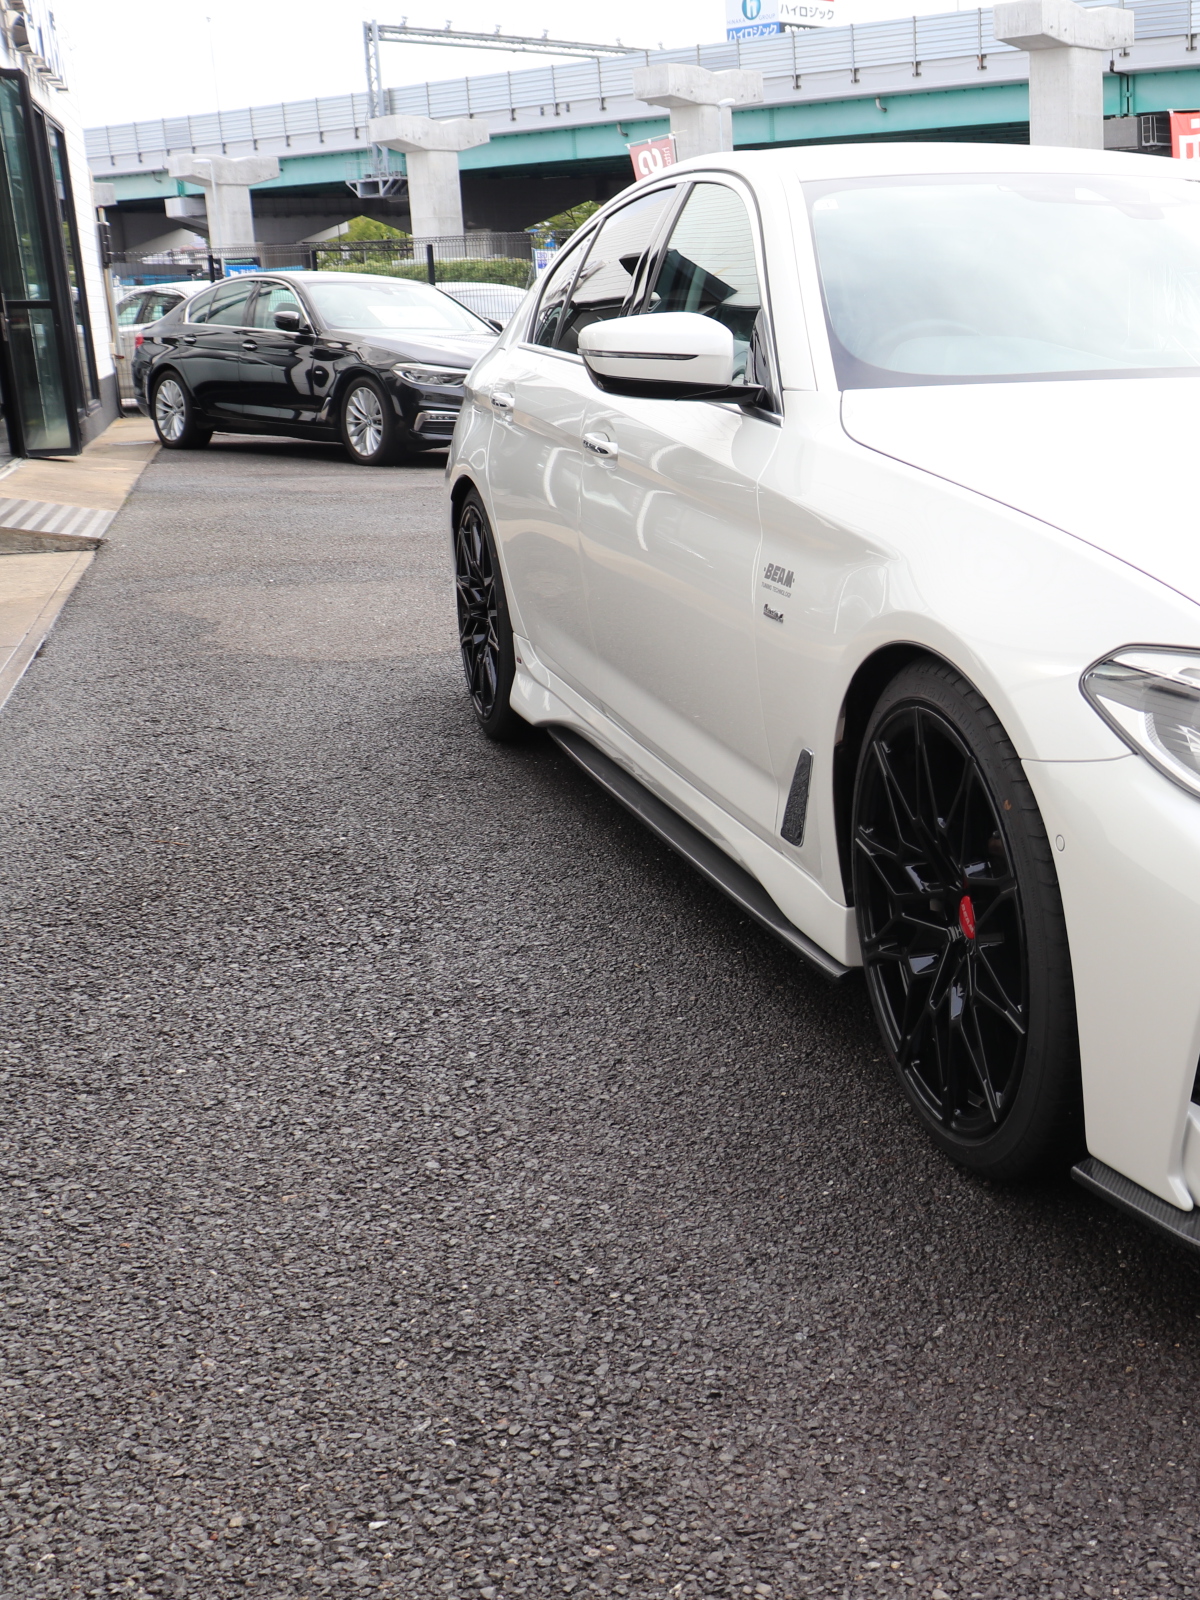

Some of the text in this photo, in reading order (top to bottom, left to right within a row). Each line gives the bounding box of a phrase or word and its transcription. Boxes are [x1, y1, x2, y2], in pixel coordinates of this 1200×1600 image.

[780, 3, 835, 20] ハイロジック
[728, 24, 777, 41] ハイロジック
[764, 563, 794, 588] BEAM
